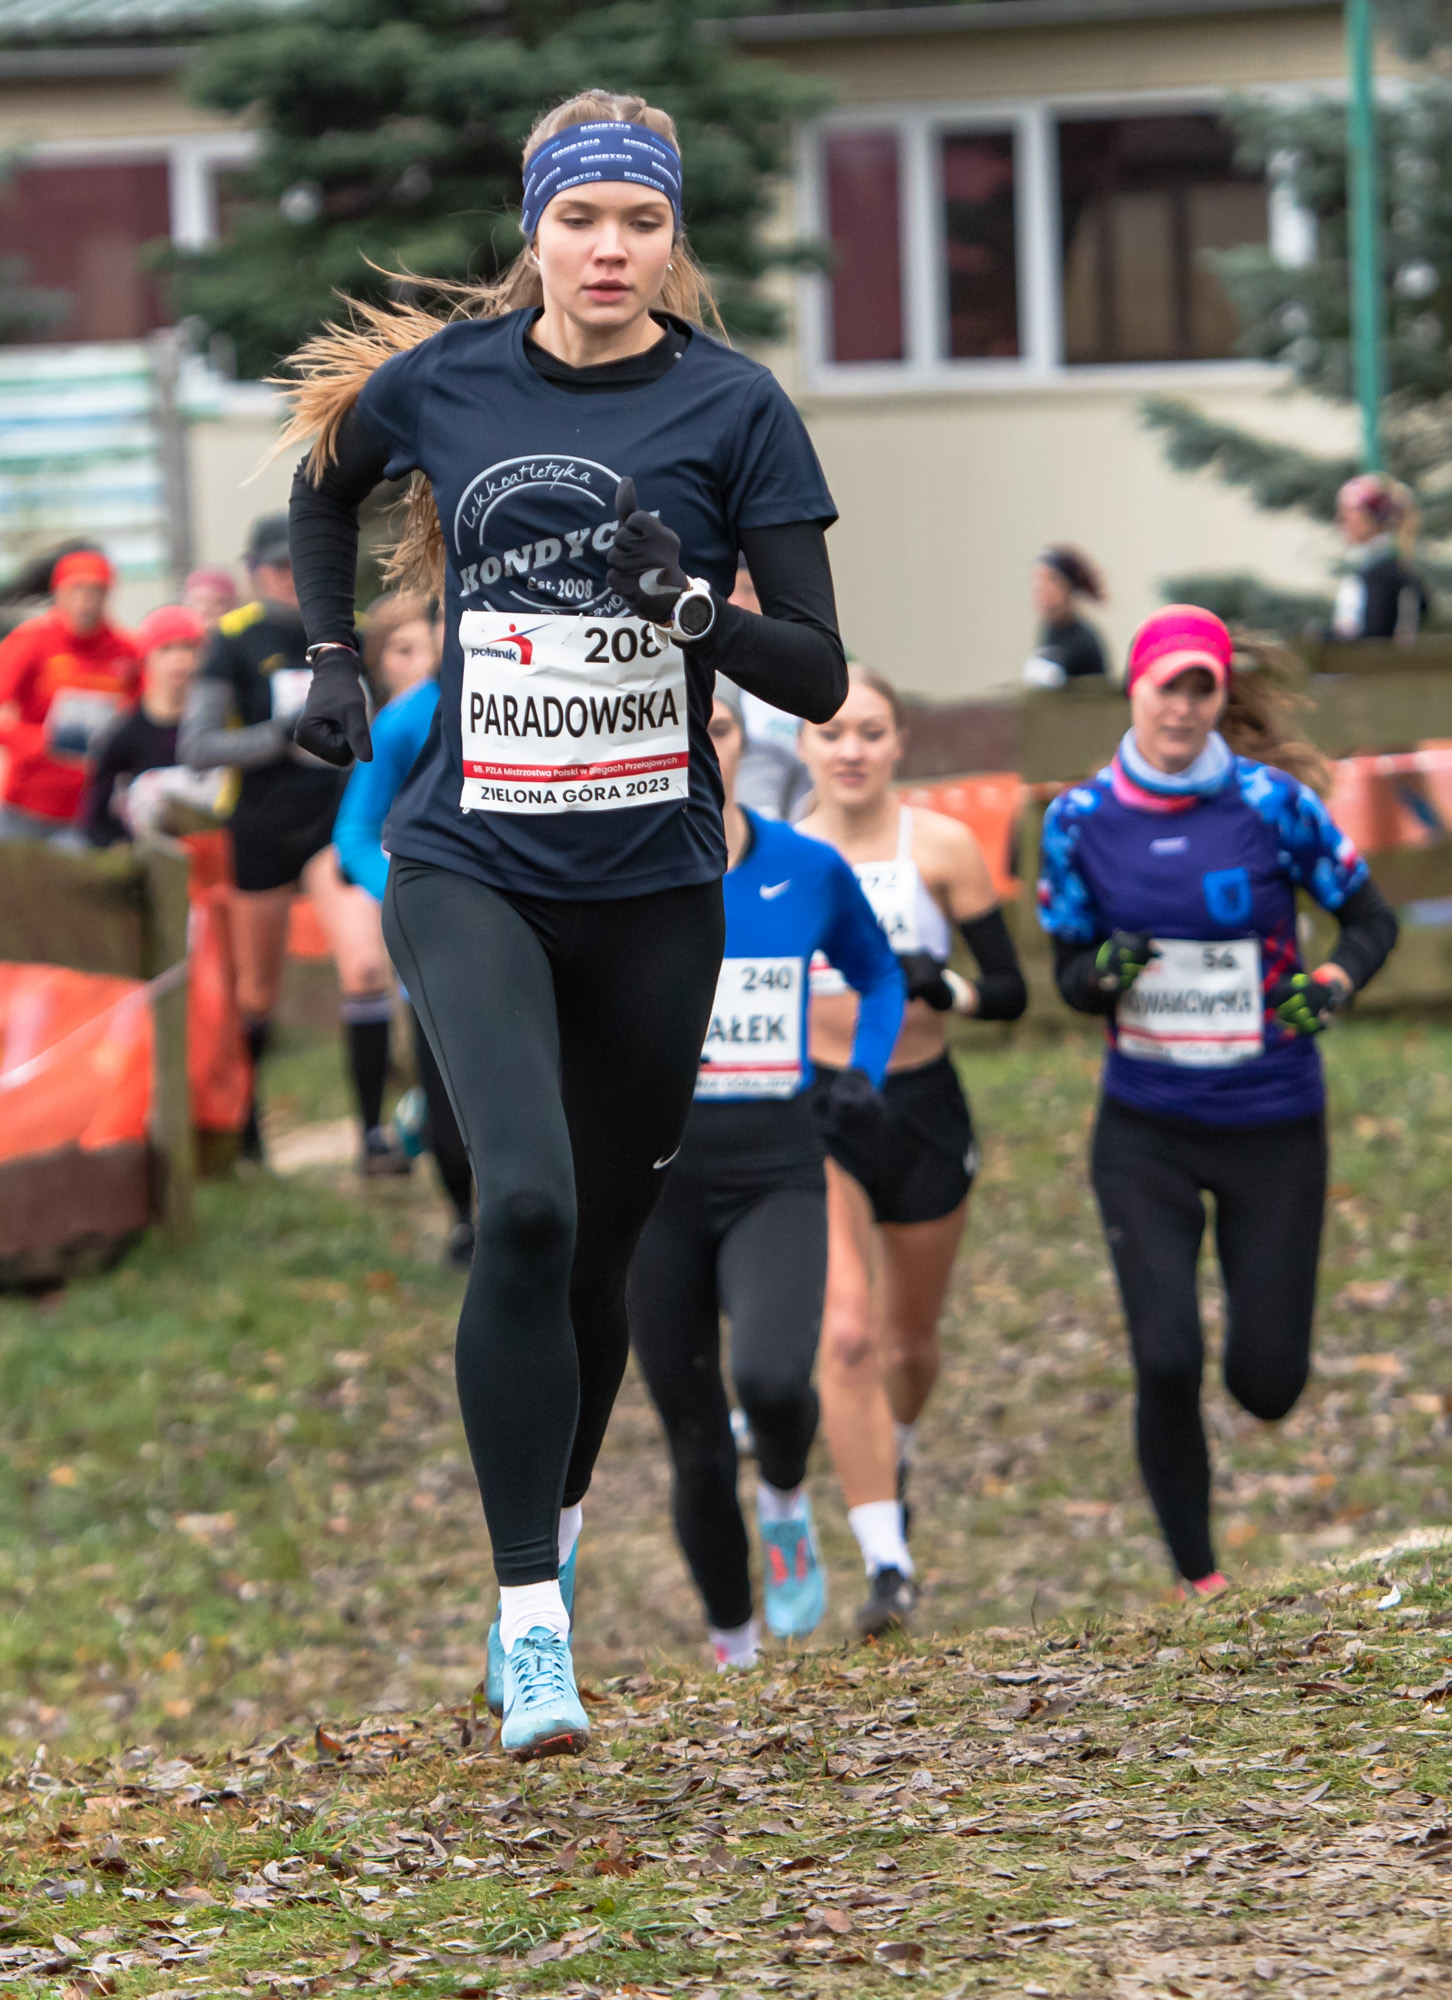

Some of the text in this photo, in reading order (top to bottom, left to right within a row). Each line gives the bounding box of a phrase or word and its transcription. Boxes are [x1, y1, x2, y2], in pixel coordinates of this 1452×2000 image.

[462, 461, 591, 529] Lekkoatletyka
[460, 509, 660, 597] KONDYC
[557, 578, 593, 599] 2008
[584, 621, 661, 664] 208
[470, 687, 679, 738] PARADOWSKA
[473, 764, 484, 774] 95.
[503, 767, 552, 777] Mistrzostwa
[553, 767, 578, 777] Polski
[480, 777, 670, 804] ZIELONA GÓRA 2023
[741, 966, 794, 991] 240
[706, 1013, 787, 1043] AŁEK
